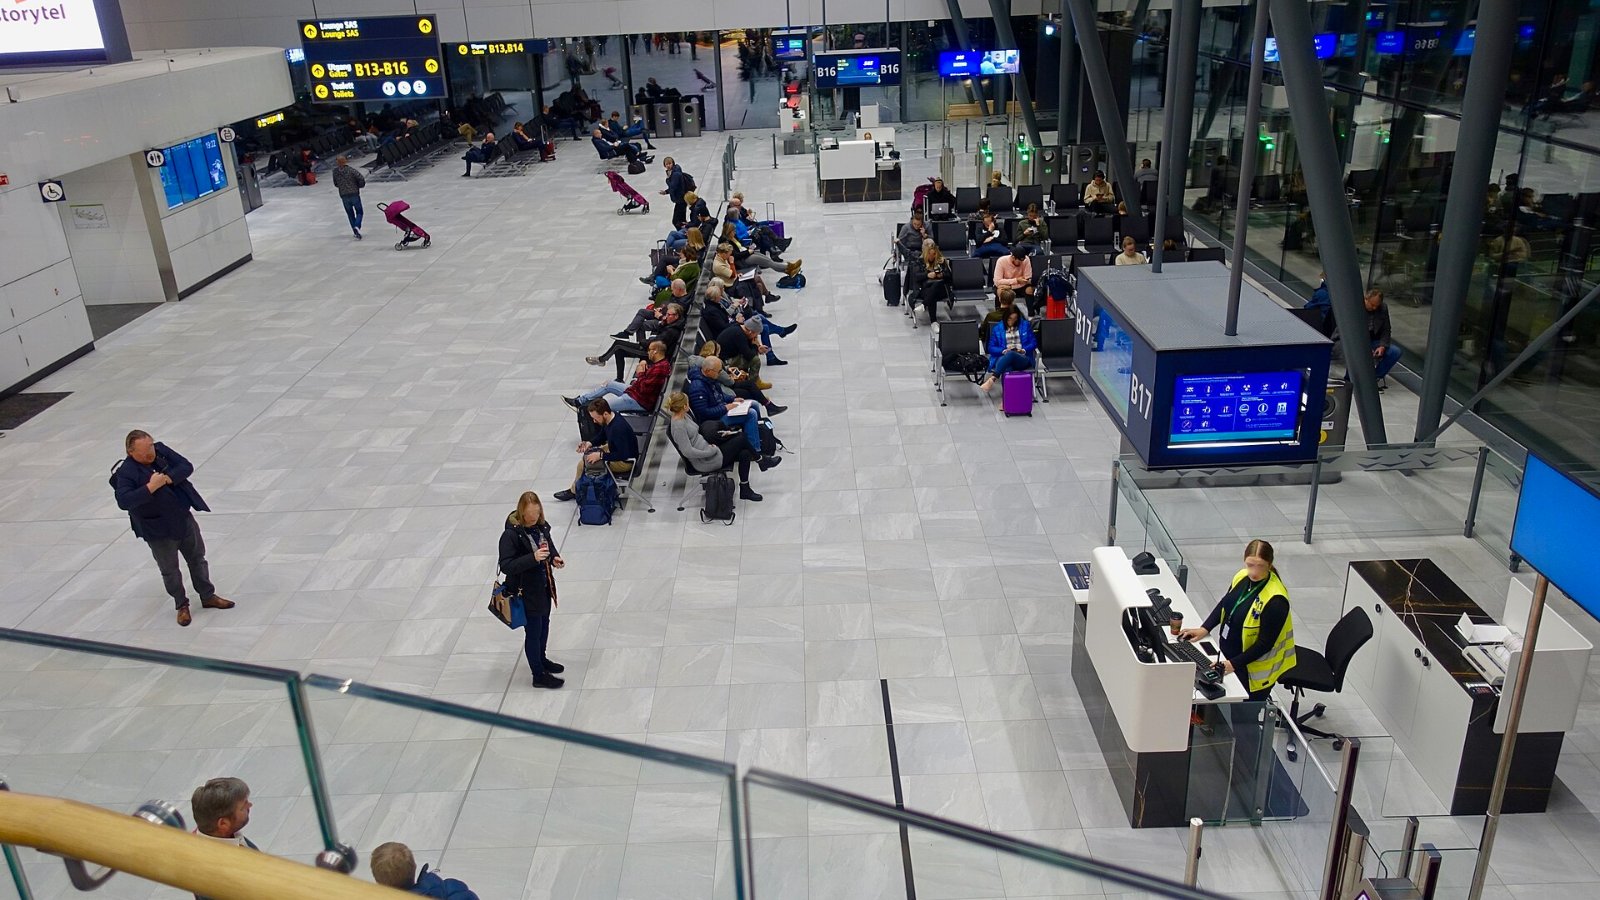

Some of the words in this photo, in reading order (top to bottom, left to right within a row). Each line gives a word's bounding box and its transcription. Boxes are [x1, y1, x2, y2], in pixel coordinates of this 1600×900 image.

[0, 4, 66, 24] torytel
[344, 21, 358, 29] SAS
[321, 30, 345, 39] Lounge
[354, 61, 409, 77] B13-B16
[817, 66, 836, 77] B16
[880, 63, 899, 74] B16
[1076, 307, 1092, 345] B17
[1131, 372, 1152, 420] B17
